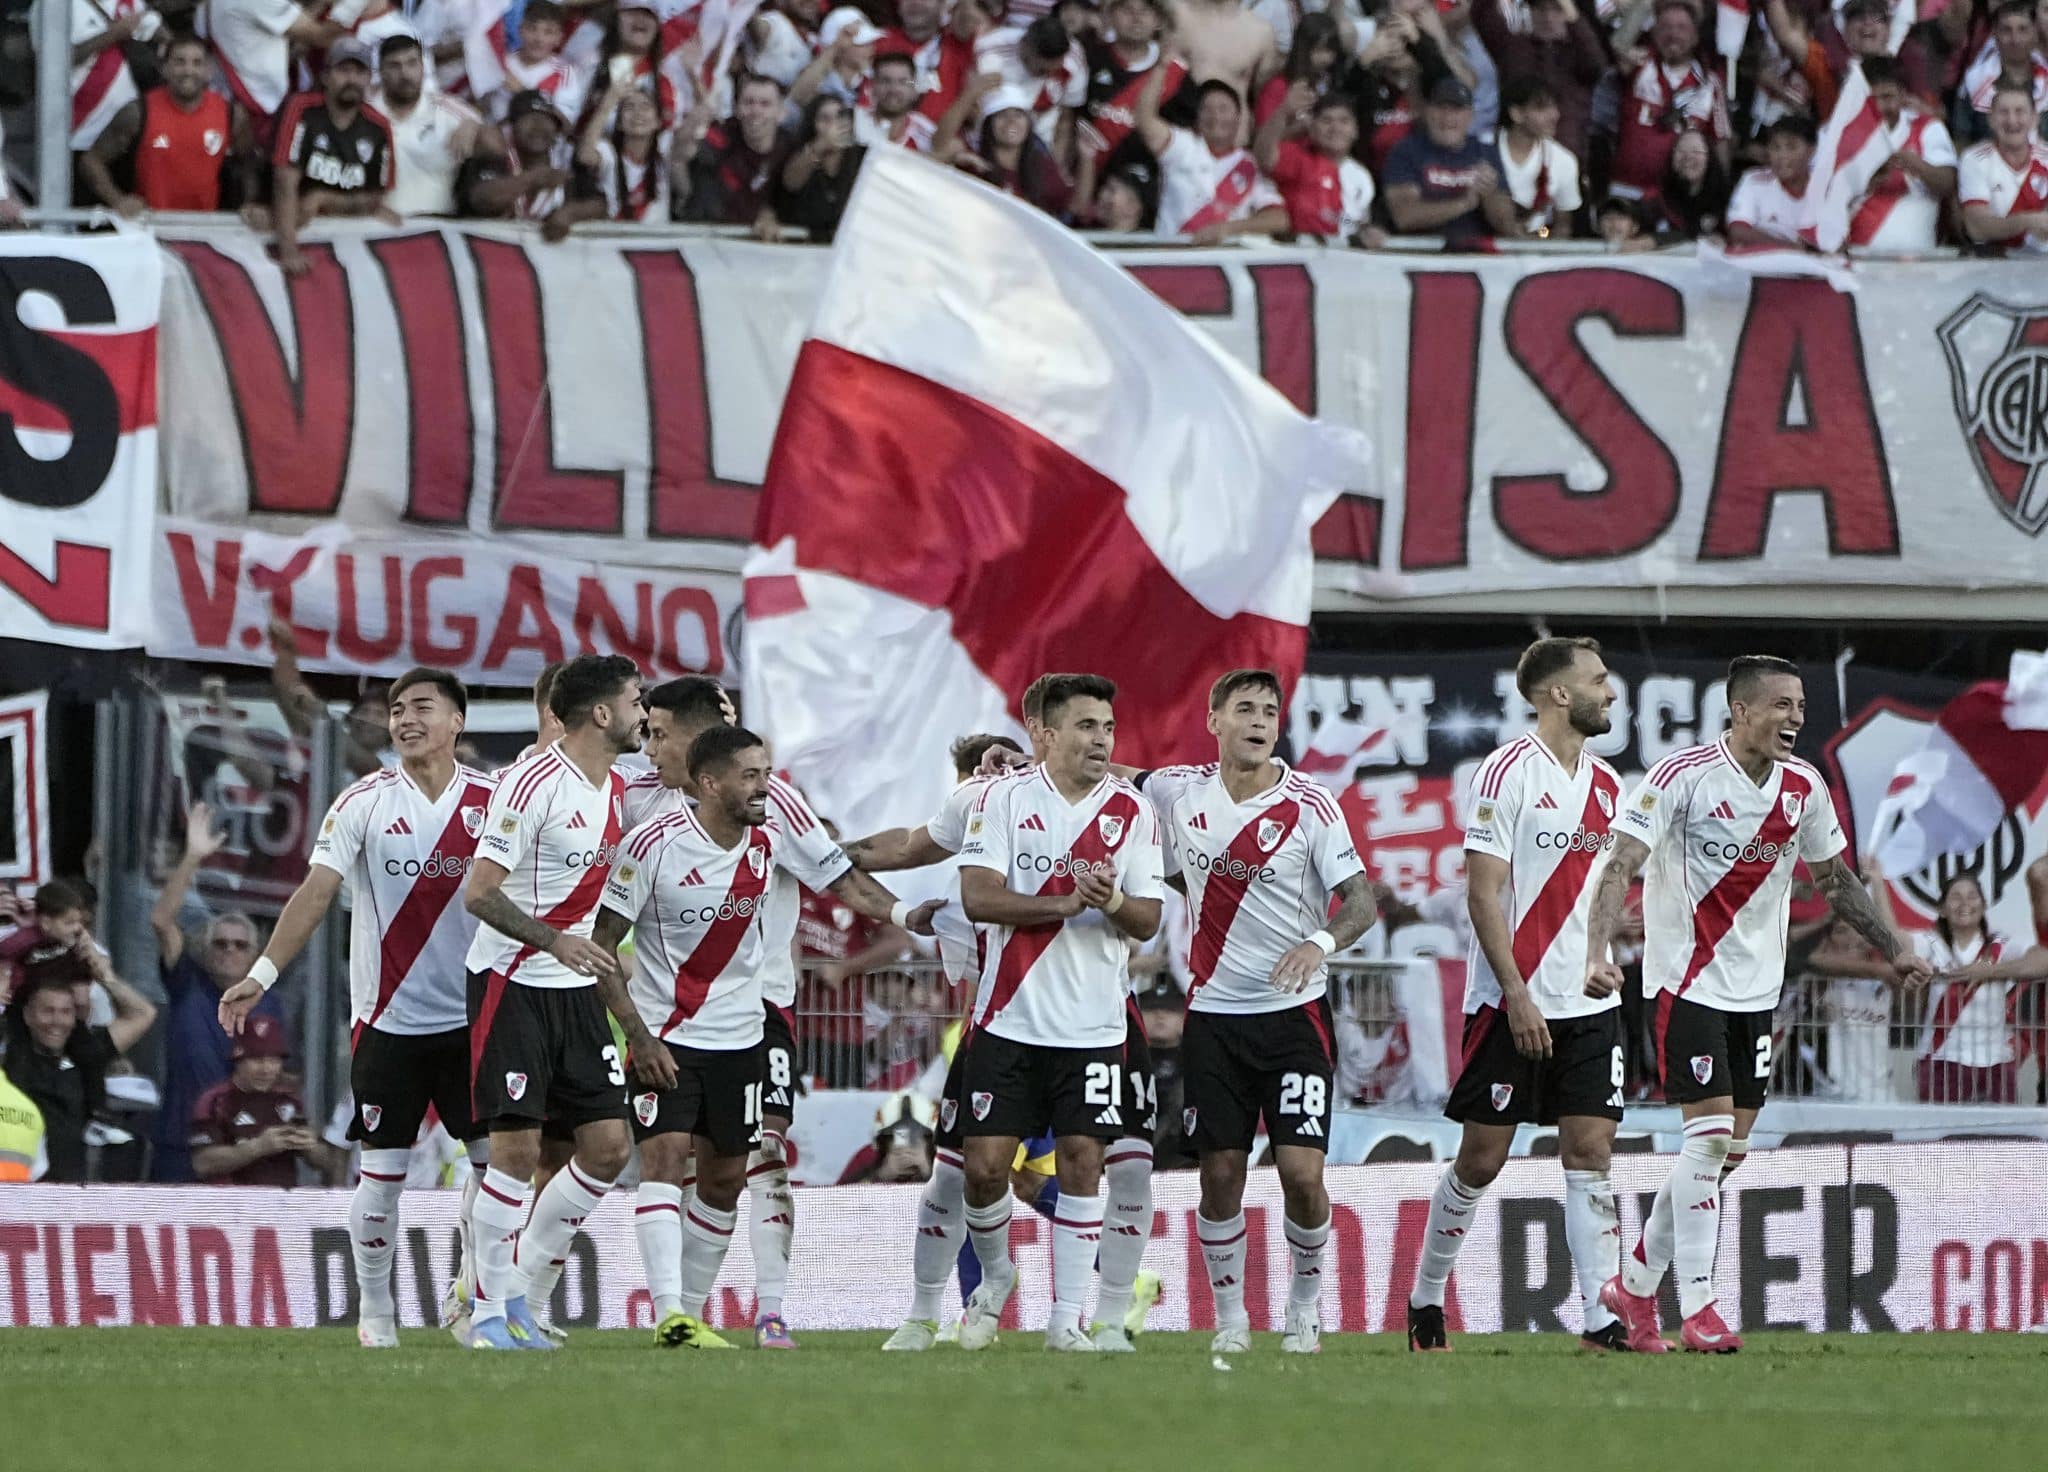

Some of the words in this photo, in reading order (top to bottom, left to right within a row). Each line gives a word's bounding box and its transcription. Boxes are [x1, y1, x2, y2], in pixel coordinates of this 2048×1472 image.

[157, 231, 768, 547] VILL
[1126, 264, 1901, 571] LISA
[384, 850, 474, 877] coder
[565, 839, 617, 868] code
[1016, 851, 1104, 878] coder
[1186, 850, 1276, 884] codere
[601, 1044, 625, 1086] 3
[766, 1047, 790, 1088] 8
[1610, 1045, 1624, 1088] 6
[1754, 1034, 1772, 1079] 2
[1085, 1062, 1122, 1107] 21
[1129, 1071, 1158, 1114] 14
[1279, 1072, 1326, 1118] 28
[0, 1222, 293, 1327] TIENDA
[1501, 1182, 1894, 1333] RER
